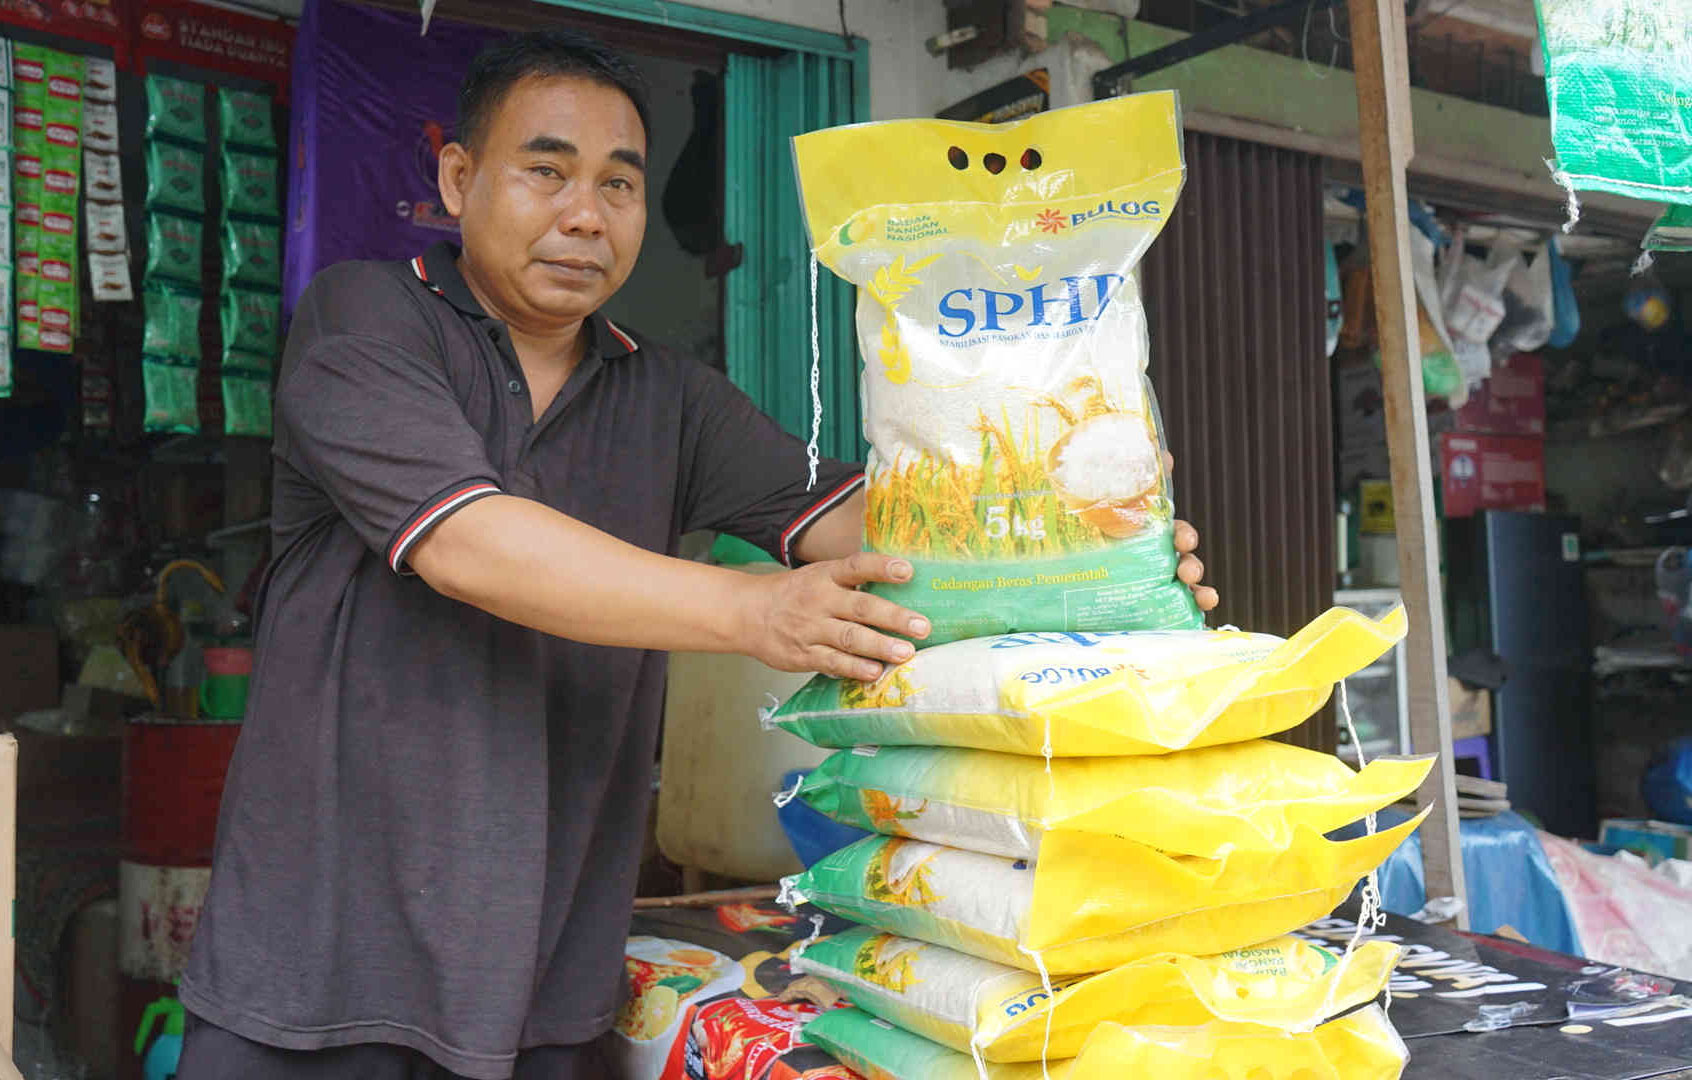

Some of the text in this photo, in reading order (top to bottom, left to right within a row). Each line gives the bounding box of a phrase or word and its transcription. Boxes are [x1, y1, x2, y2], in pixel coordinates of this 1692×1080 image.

[1071, 200, 1160, 226] BULOG
[886, 228, 948, 241] NASIONAL
[887, 221, 939, 233] PANGAN
[986, 505, 1010, 539] 5
[932, 566, 1109, 592] Cadangan Beras Pemerintah
